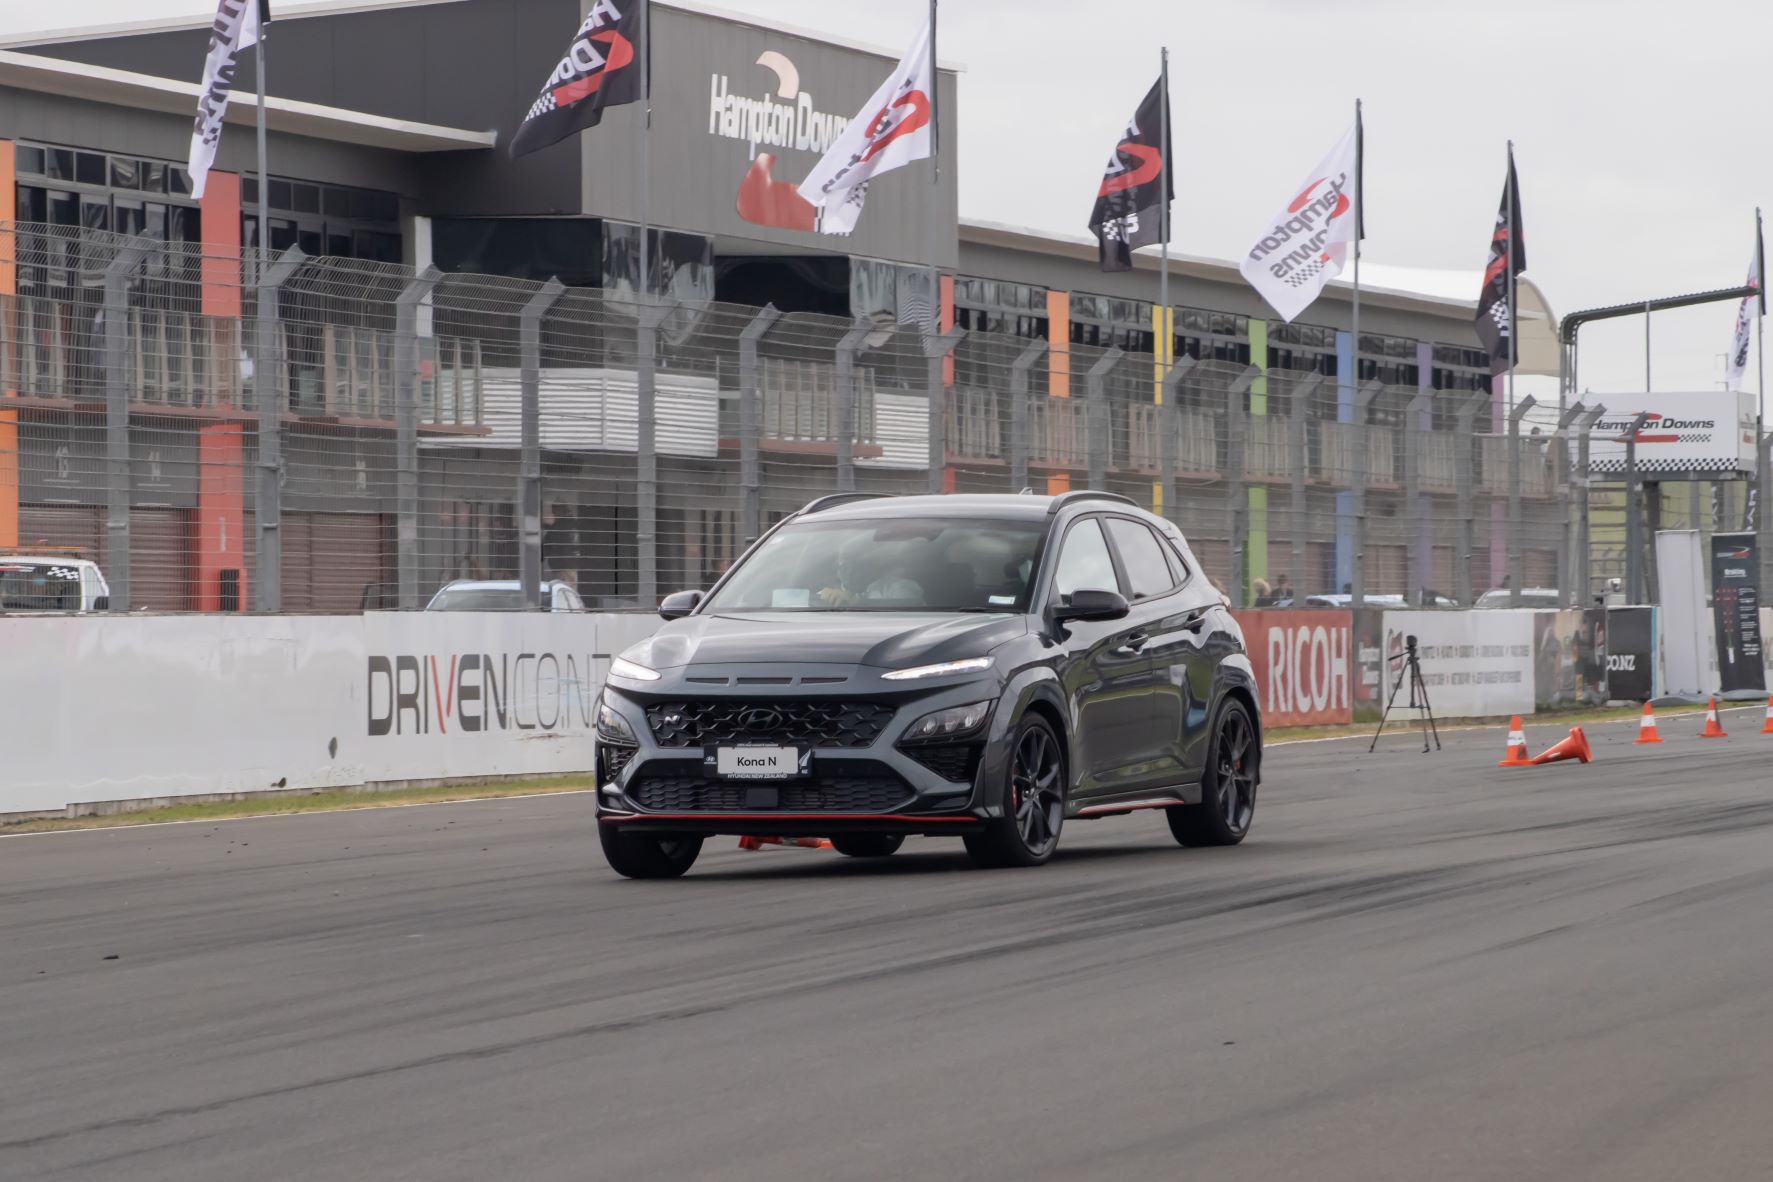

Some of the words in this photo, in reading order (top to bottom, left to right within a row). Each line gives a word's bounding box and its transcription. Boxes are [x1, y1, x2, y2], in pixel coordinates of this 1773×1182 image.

[709, 73, 795, 161] Hampton
[795, 91, 856, 155] Down
[1661, 418, 1715, 429] Downs
[1267, 625, 1348, 713] RICOH
[737, 756, 765, 767] Kona
[768, 756, 777, 766] N
